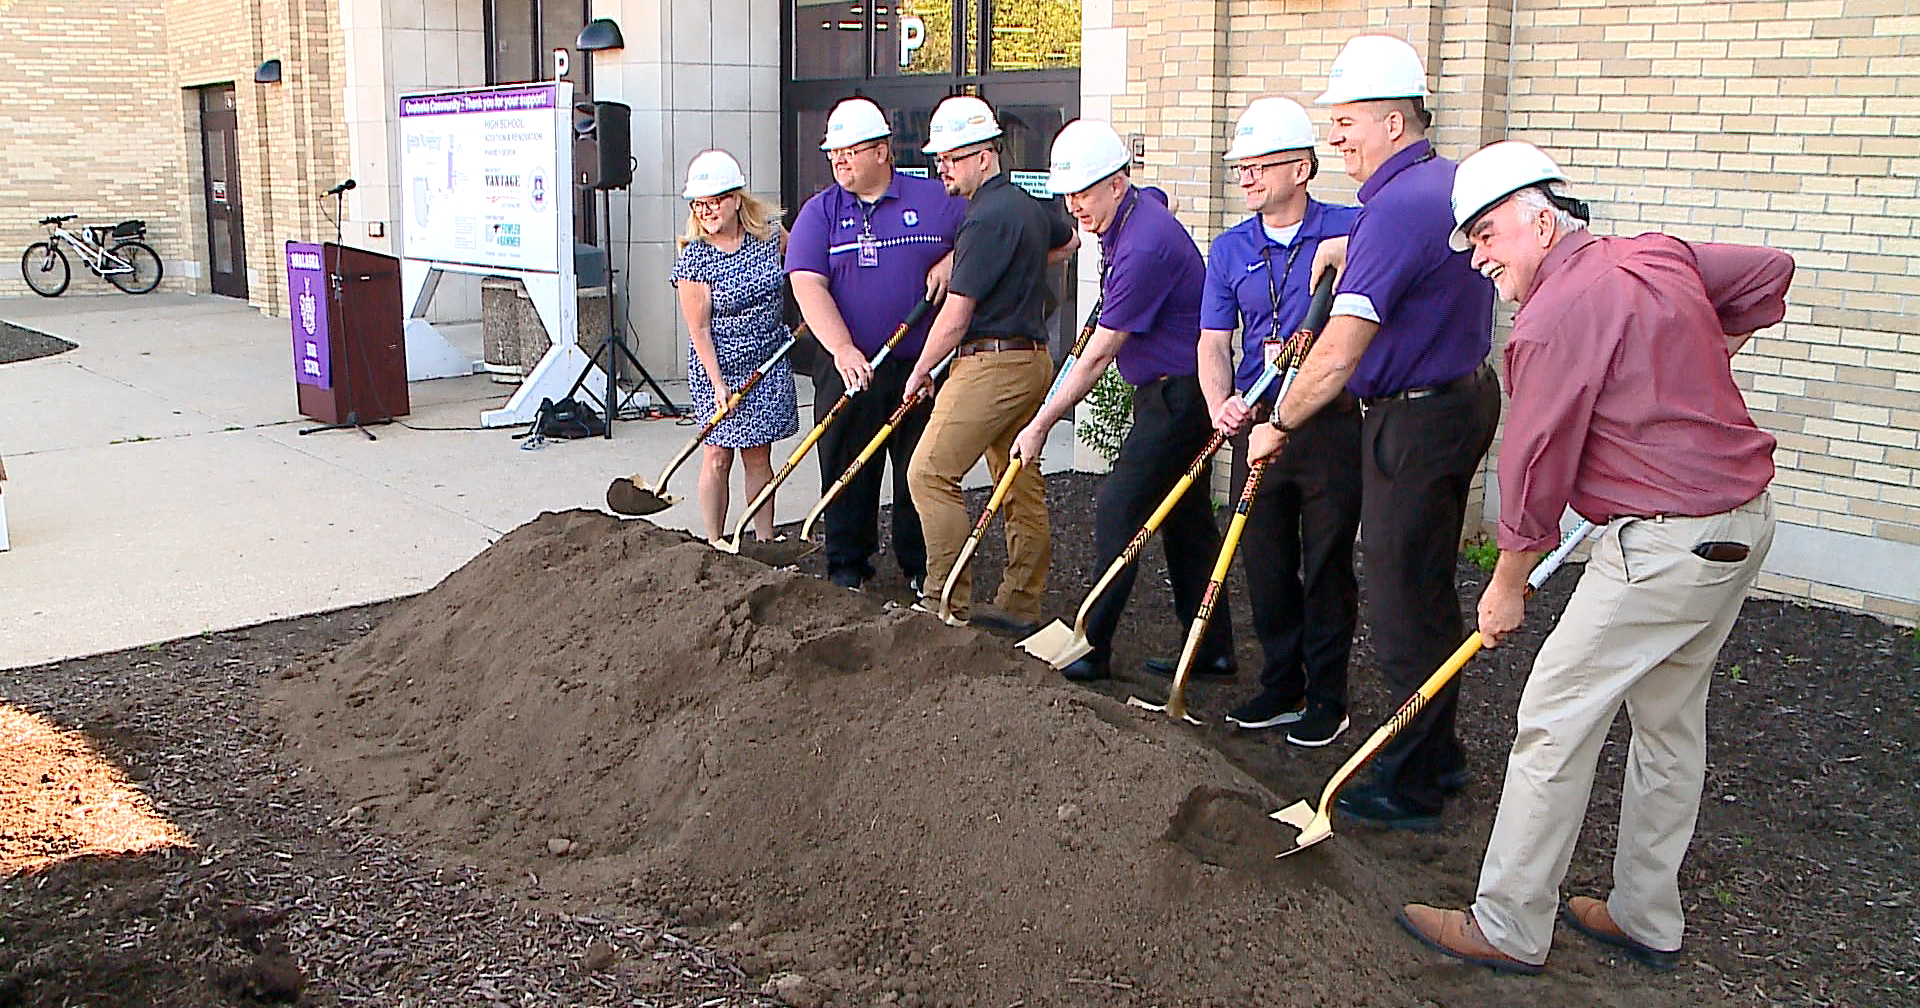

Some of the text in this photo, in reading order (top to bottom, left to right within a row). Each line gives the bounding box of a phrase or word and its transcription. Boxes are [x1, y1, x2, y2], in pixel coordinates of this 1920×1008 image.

[901, 18, 925, 66] P
[430, 98, 460, 114] Community
[465, 96, 482, 111] Thank
[483, 97, 494, 112] you
[495, 94, 504, 110] for
[504, 95, 519, 111] your
[519, 90, 547, 109] support!
[485, 118, 524, 130] HIGH SCHOOL
[512, 132, 542, 142] RENOVATION
[485, 174, 520, 188] VANTAGE
